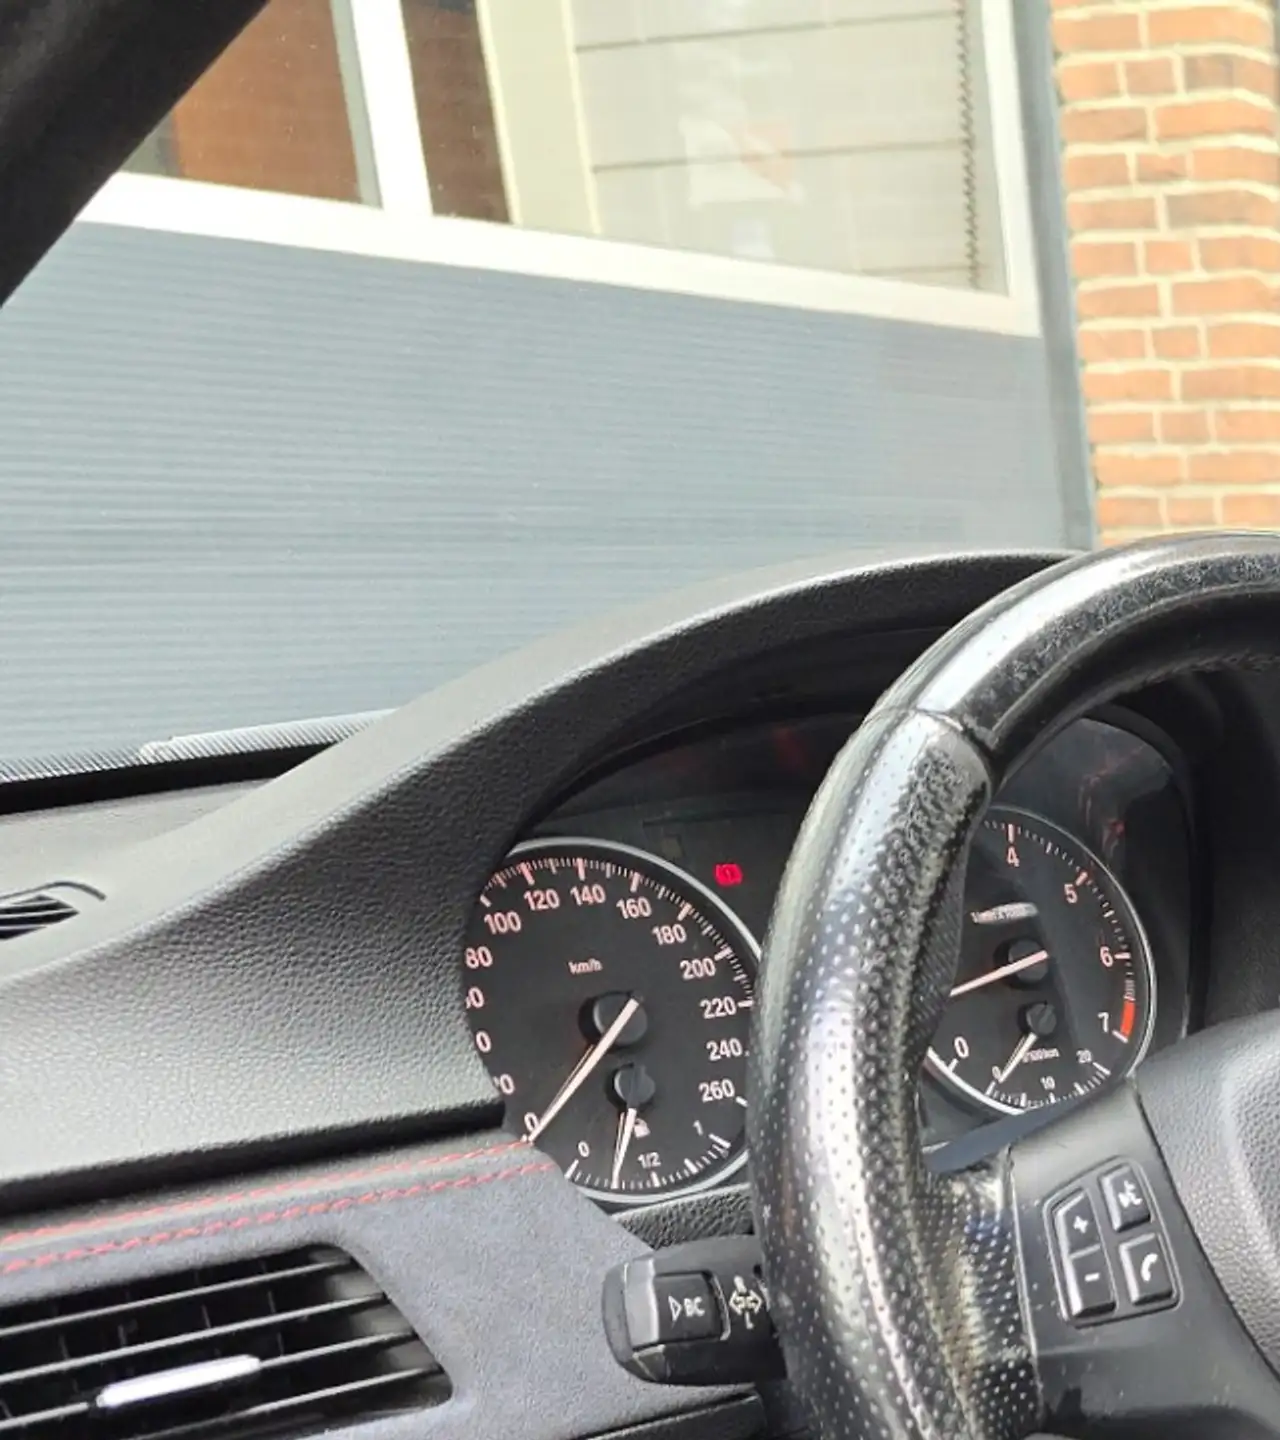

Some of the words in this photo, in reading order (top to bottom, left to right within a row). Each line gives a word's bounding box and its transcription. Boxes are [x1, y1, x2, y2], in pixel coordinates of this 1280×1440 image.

[1006, 847, 1020, 868] 4
[524, 888, 560, 911] 120
[570, 884, 606, 906] 140
[1064, 883, 1078, 904] 5
[616, 897, 652, 920] 160
[484, 911, 522, 935] 100
[652, 923, 687, 946] 180
[465, 946, 493, 969] 80
[568, 958, 603, 975] km/h
[1100, 946, 1114, 967] 6
[680, 957, 716, 980] 200
[465, 986, 485, 1009] 0
[700, 995, 737, 1019] 220
[1098, 1012, 1110, 1032] 7
[706, 1038, 742, 1061] 240
[954, 1036, 970, 1059] 0
[1076, 1048, 1092, 1064] 20
[699, 1079, 735, 1103] 260
[1040, 1076, 1056, 1091] 10
[693, 1120, 704, 1137] 1
[577, 1140, 590, 1159] 0
[637, 1151, 662, 1169] 1/2
